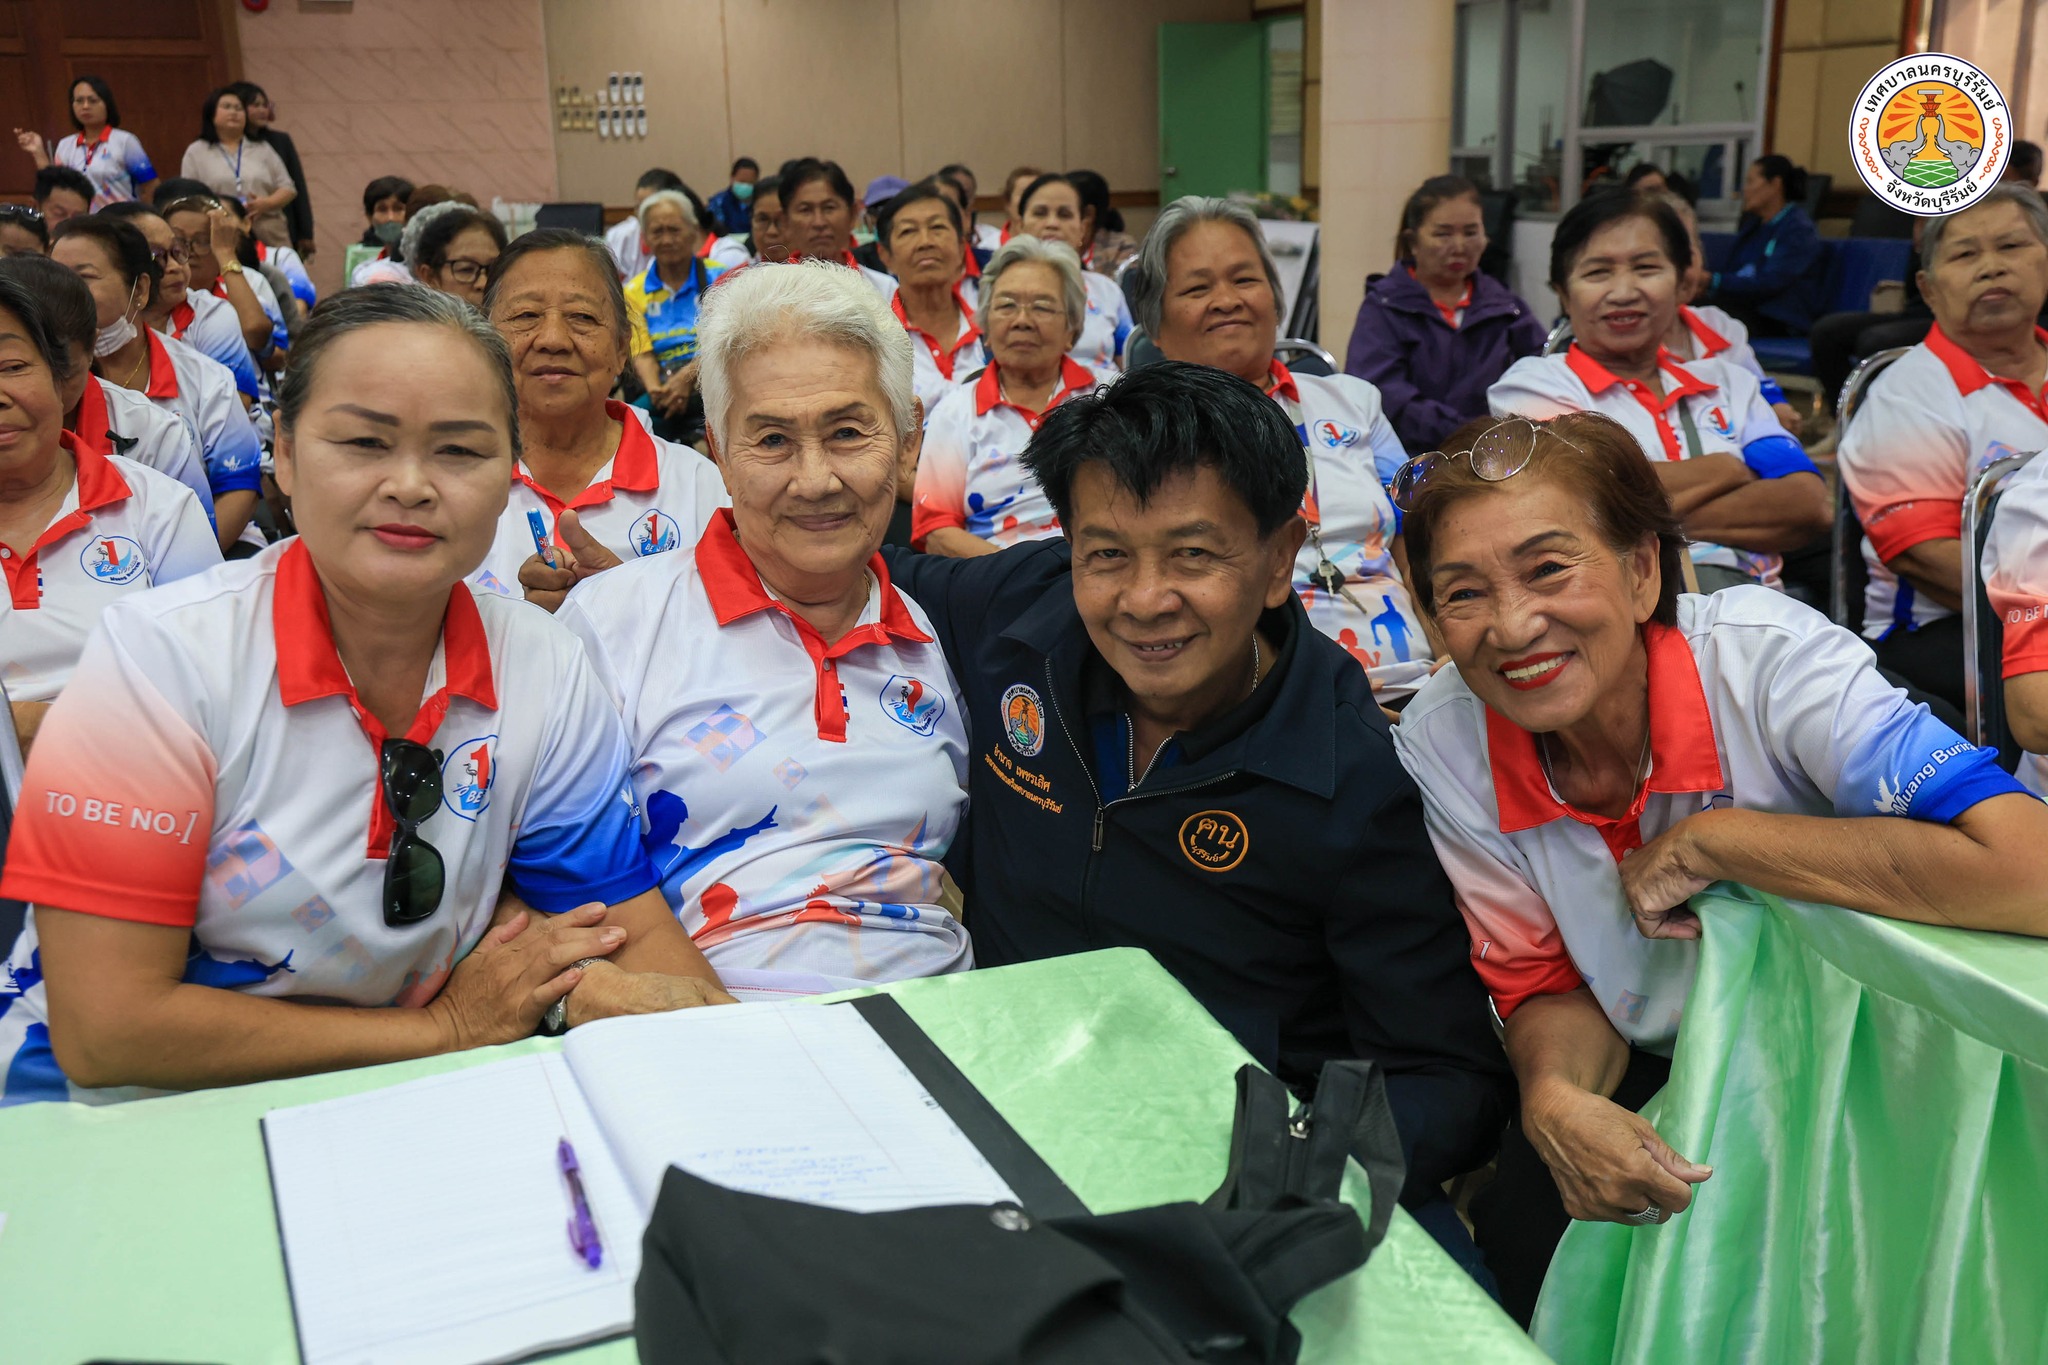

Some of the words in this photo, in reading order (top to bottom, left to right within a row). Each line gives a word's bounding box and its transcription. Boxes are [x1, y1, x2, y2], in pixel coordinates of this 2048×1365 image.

[2024, 605, 2041, 622] BE
[1891, 762, 1937, 817] Muang
[46, 790, 77, 817] TO
[83, 798, 123, 826] BE
[130, 807, 200, 845] NO.1
